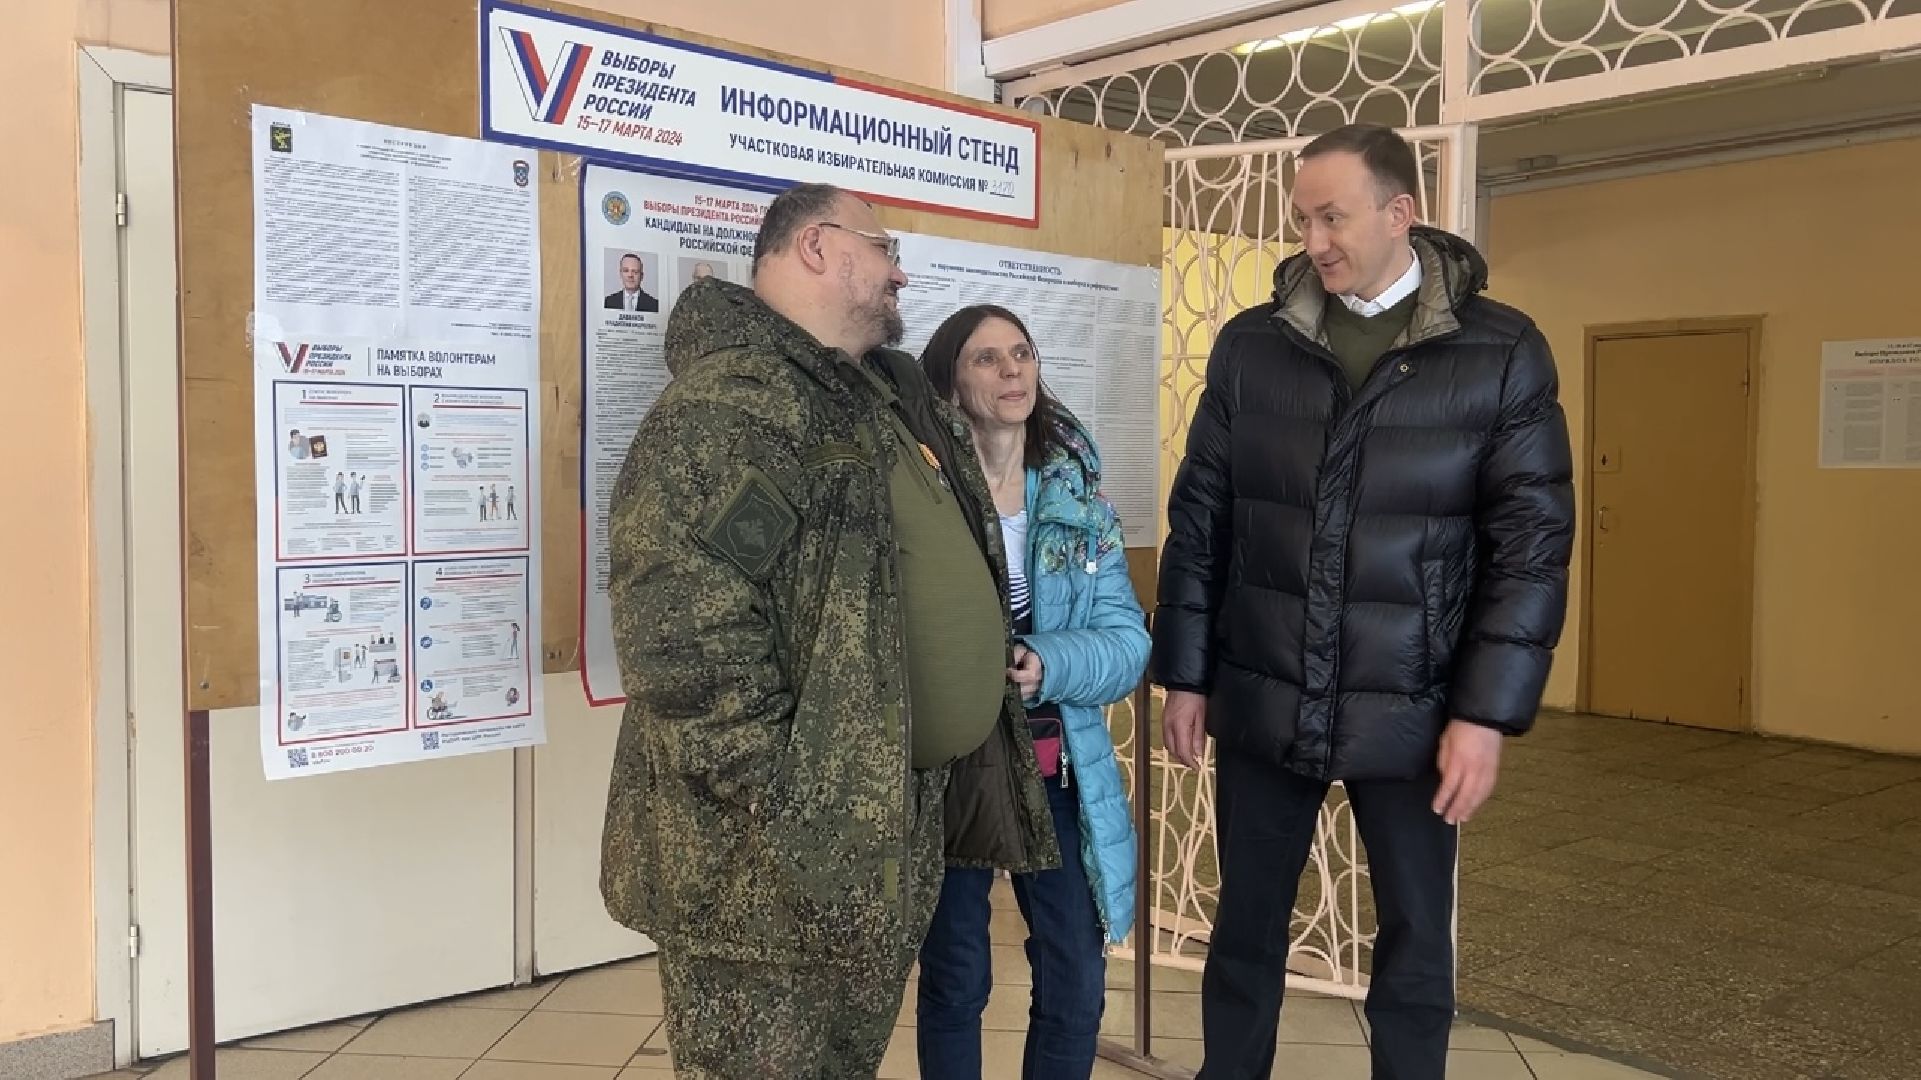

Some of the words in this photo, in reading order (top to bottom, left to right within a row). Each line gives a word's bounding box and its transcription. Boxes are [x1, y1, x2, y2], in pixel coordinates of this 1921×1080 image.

[601, 50, 677, 79] ВЫБОРЫ
[592, 72, 696, 107] ПРЕЗИДЕНТА
[583, 93, 653, 121] РОССИИ
[612, 121, 653, 140] МАРТА
[654, 128, 683, 146] 2024
[721, 85, 952, 158] ИНФОРМАЦИОННЫЙ
[958, 136, 1019, 175] СТЕНД
[729, 133, 814, 162] УЧАСТКОВАЯ
[817, 149, 916, 180] ИЗБИРАТЕЛЬНАЯ
[917, 168, 976, 192] КОМИССИЯ
[977, 178, 989, 192] №
[643, 200, 680, 214] ВЫБОРЫ
[681, 205, 729, 222] ПРЕЗИДЕНТА
[714, 197, 740, 210] МАРТА
[741, 202, 758, 213] 2024
[645, 216, 700, 235] КАНДИДАТЫ
[702, 224, 715, 237] НА
[716, 227, 760, 242] ДОЛЖНО
[679, 237, 738, 255] РОССИЙСКОЙ
[740, 245, 754, 257] ФЕ
[377, 347, 425, 362] ПАМЯТКА
[428, 351, 496, 365] ВОЛОНТЕРАМ
[377, 364, 391, 376] НА
[393, 365, 443, 379] ВЫБОРАХ
[433, 393, 440, 403] 2
